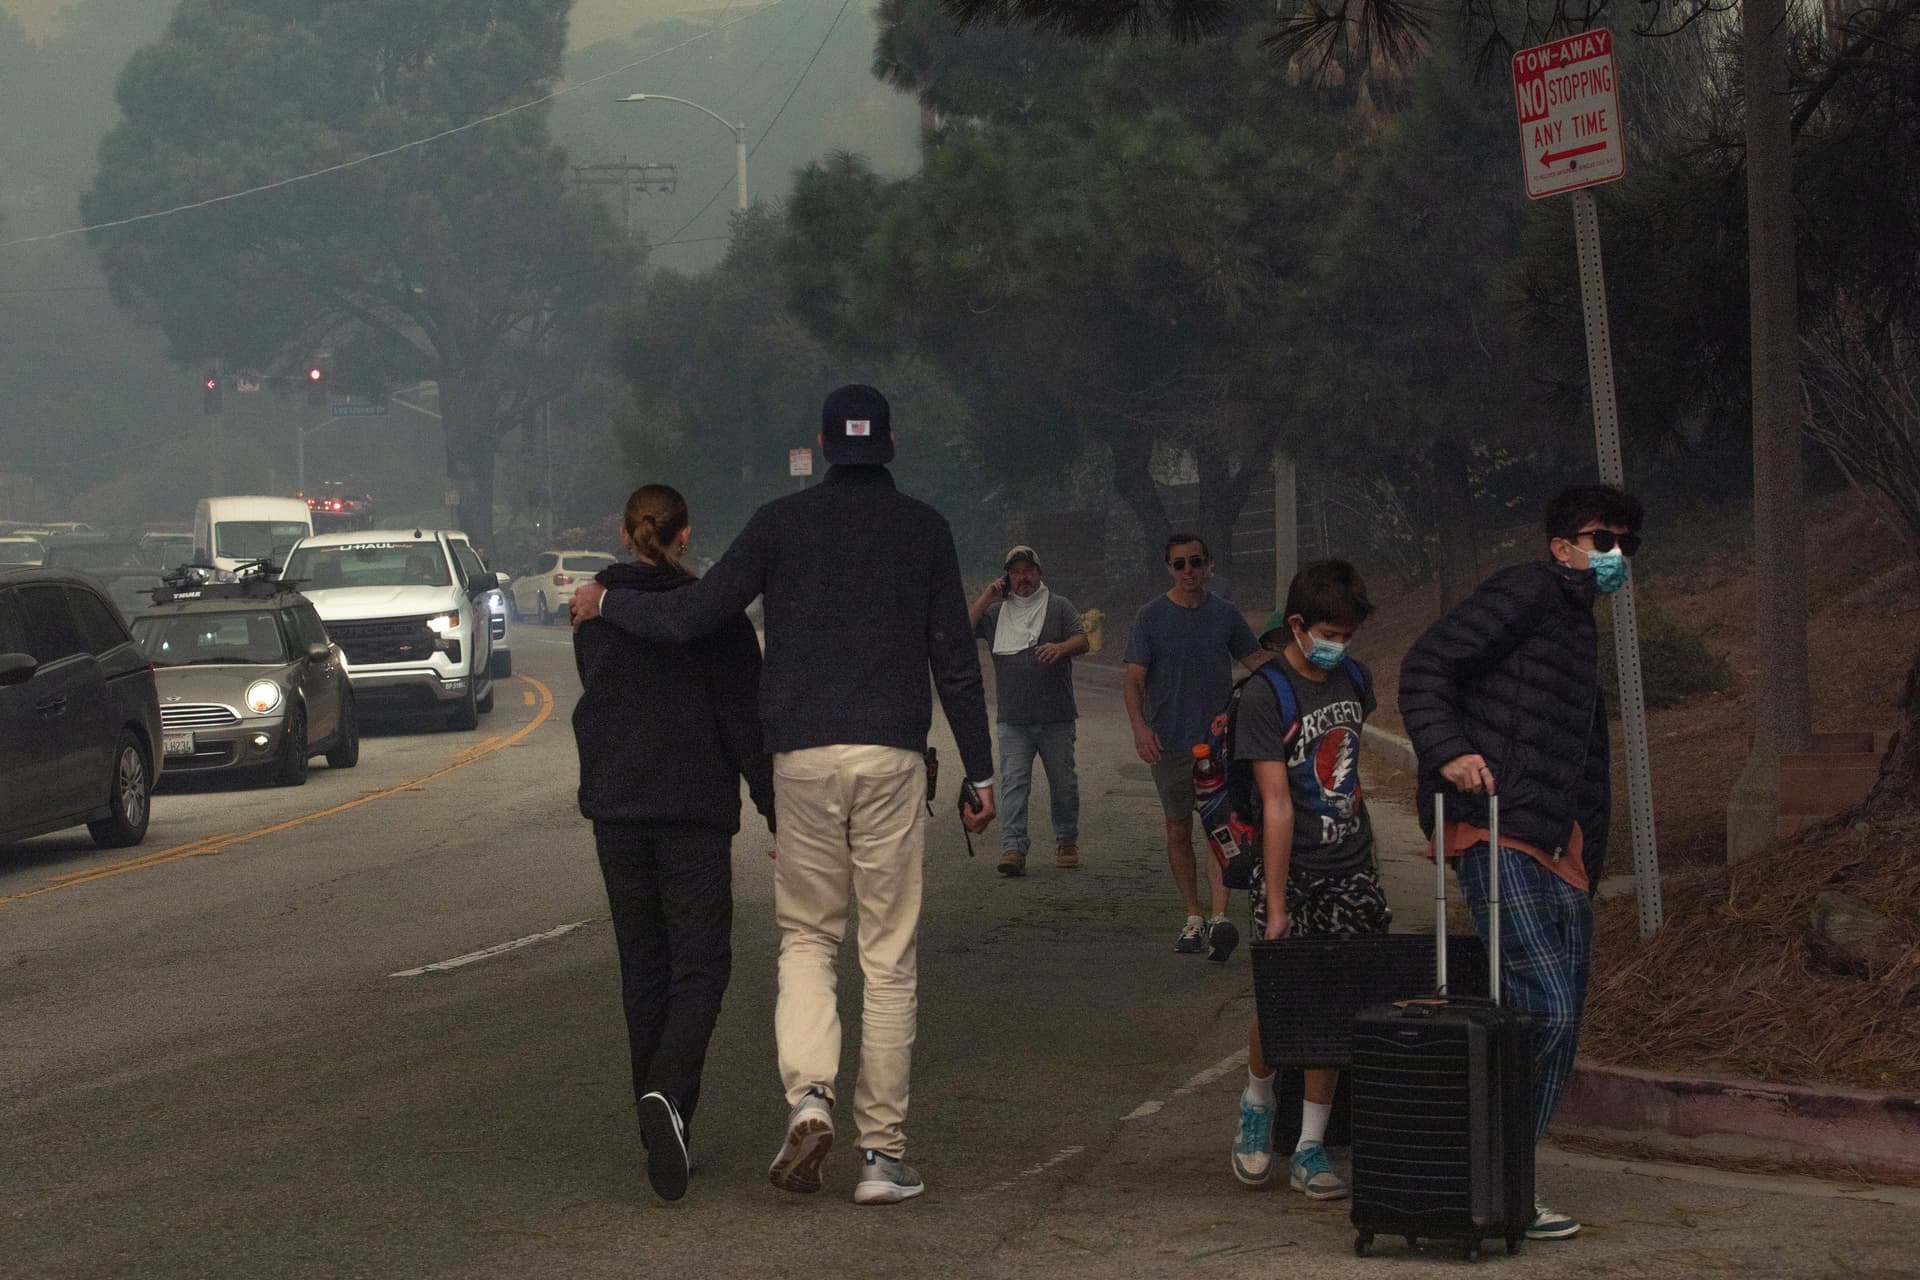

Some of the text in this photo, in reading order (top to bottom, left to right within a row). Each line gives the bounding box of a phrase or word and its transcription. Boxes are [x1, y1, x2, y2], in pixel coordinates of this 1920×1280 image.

[1516, 32, 1607, 74] TOW-AWAY
[1518, 65, 1611, 119] NO STOPPING
[1534, 109, 1608, 149] ANY TIME
[339, 543, 395, 551] U-HAUL
[173, 591, 201, 599] THULE
[1288, 701, 1363, 768] GRATEFU
